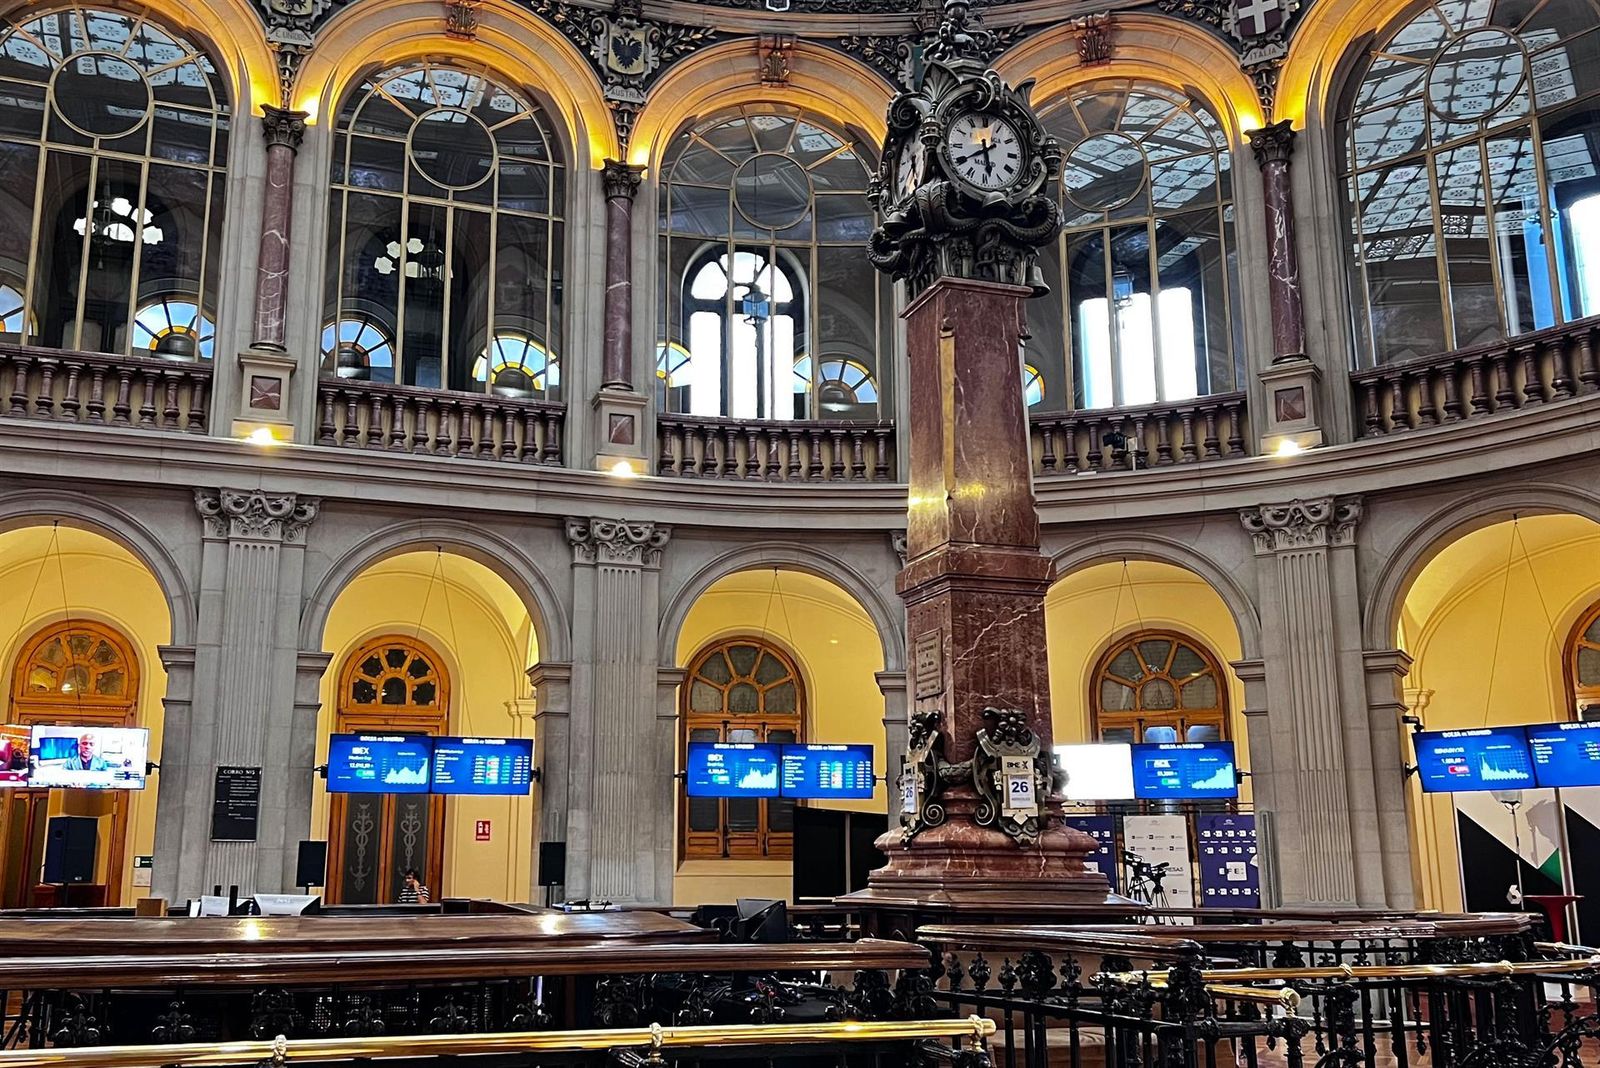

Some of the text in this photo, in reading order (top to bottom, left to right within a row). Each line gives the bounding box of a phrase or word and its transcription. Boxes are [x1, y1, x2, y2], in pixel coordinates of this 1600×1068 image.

[1250, 47, 1276, 61] ITALIA
[611, 89, 640, 98] AUSTRIA
[905, 786, 914, 798] 26
[1011, 781, 1029, 793] 26
